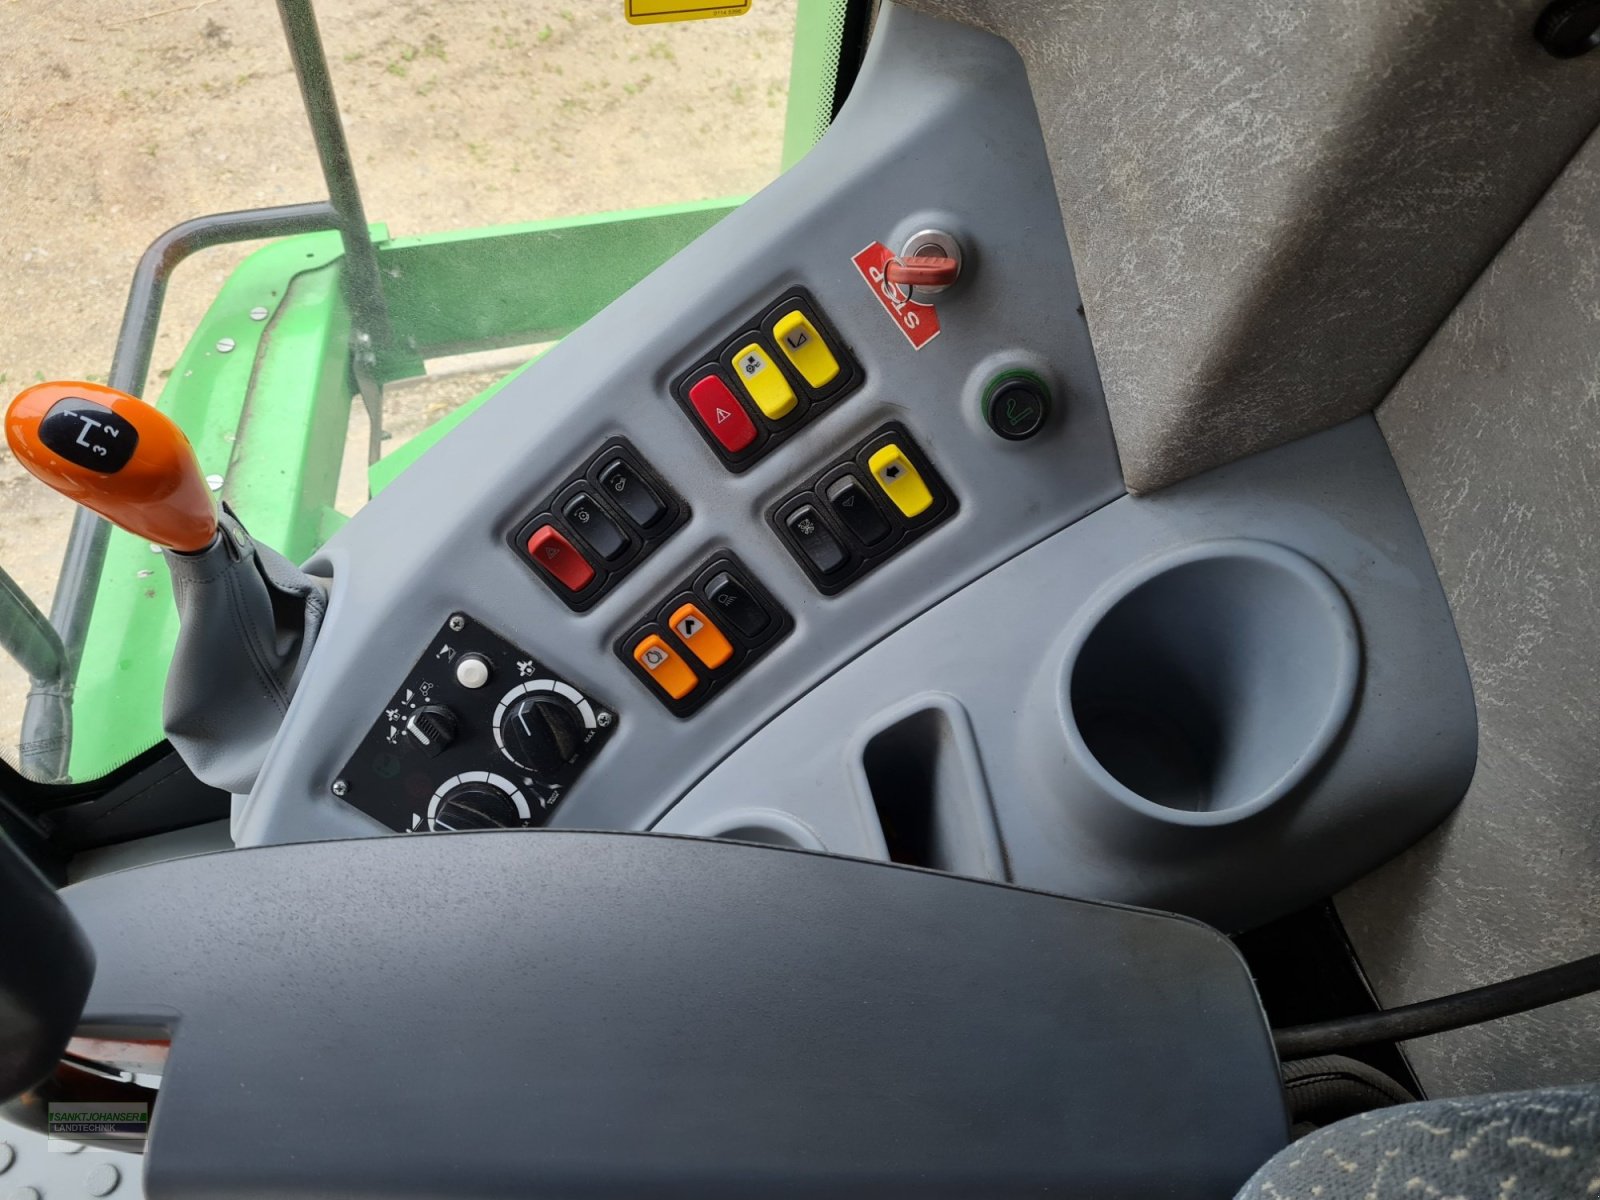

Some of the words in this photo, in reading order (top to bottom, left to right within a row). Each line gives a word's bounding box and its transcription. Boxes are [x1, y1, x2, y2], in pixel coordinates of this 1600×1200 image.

[868, 266, 920, 329] STOP
[104, 425, 119, 438] 2
[93, 445, 107, 456] 3
[584, 730, 595, 743] MAX
